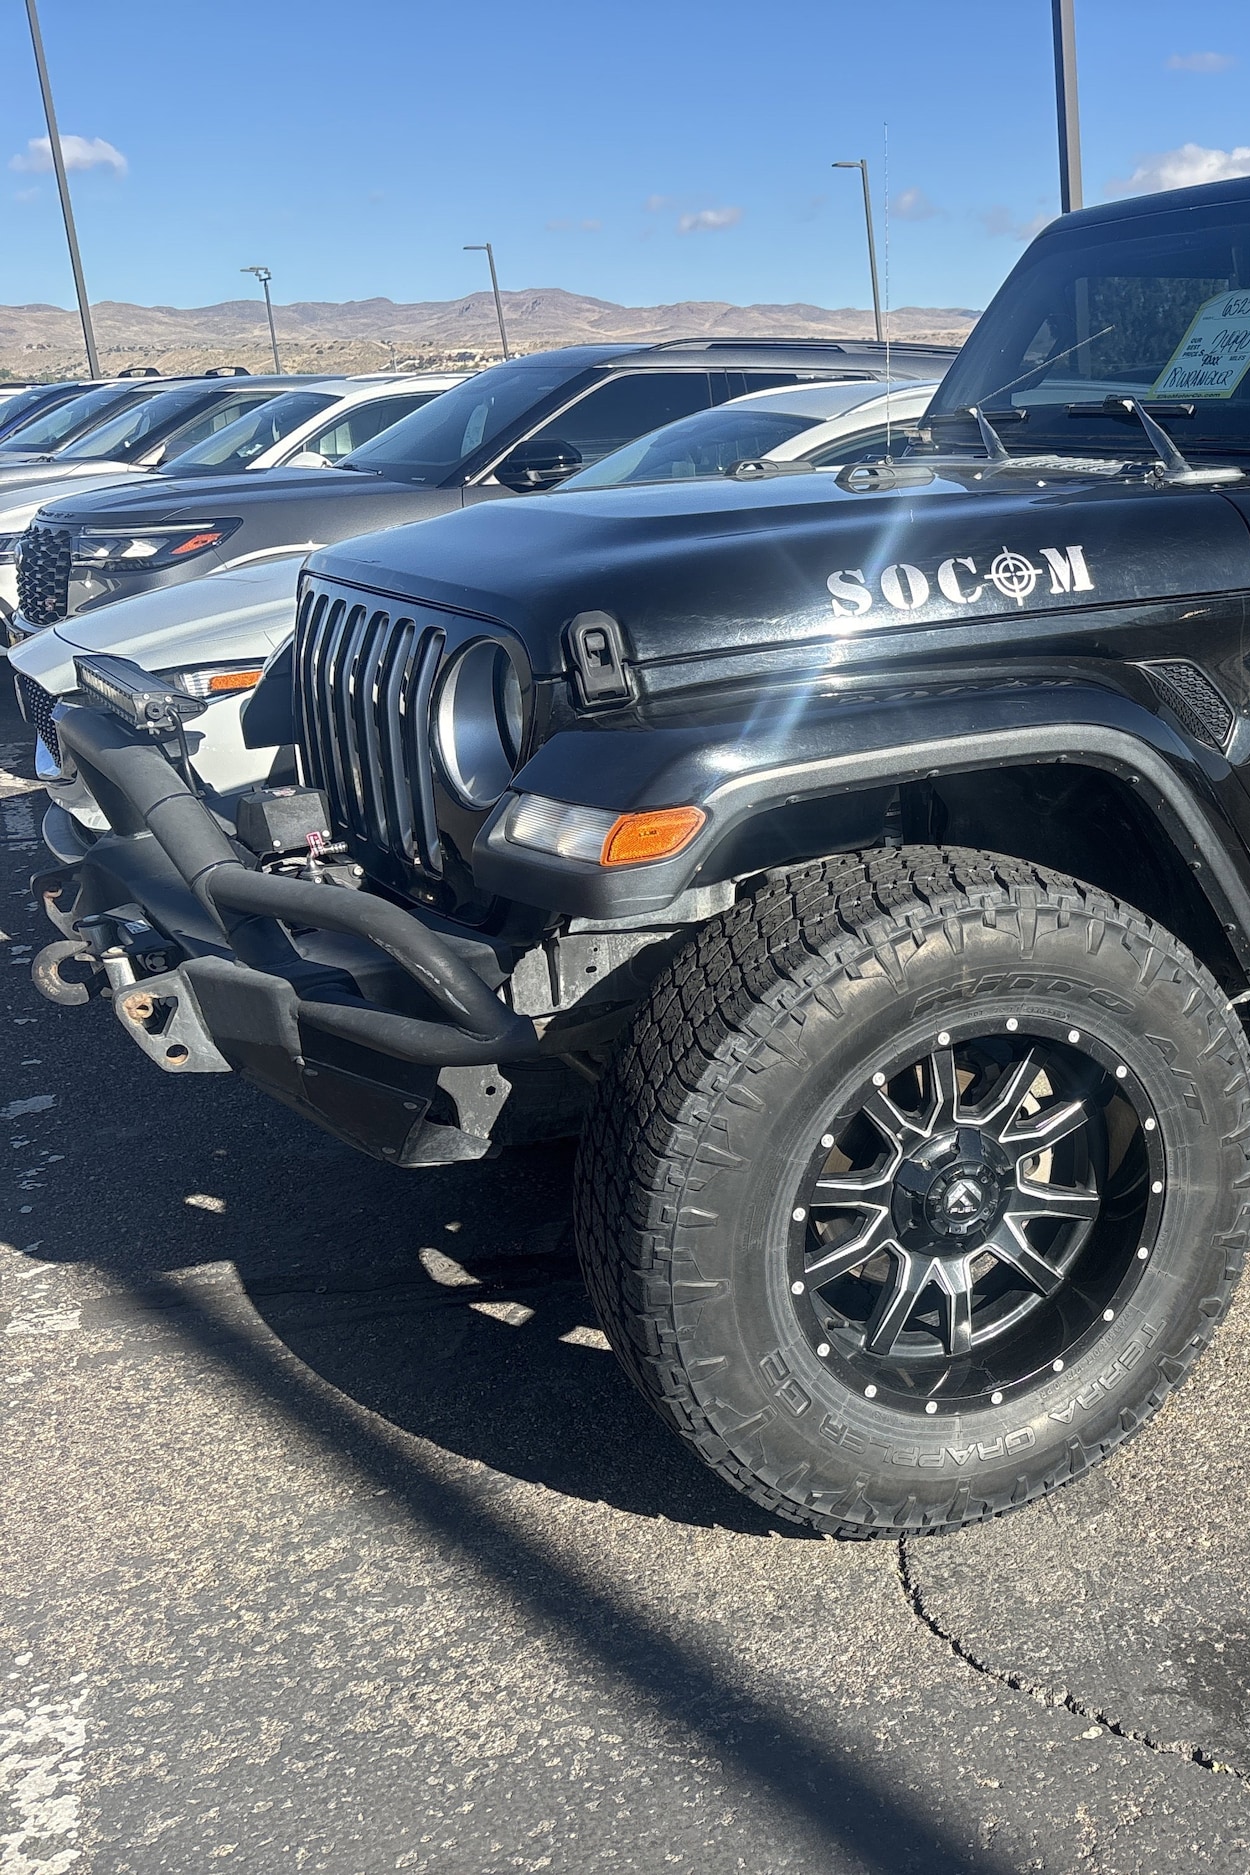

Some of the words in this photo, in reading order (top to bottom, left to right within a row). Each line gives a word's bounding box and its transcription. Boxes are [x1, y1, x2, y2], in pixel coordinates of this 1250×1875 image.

[759, 1349, 812, 1418] G2
[1049, 1319, 1168, 1424] TERRA
[819, 1412, 1036, 1469] GRAPPLER
